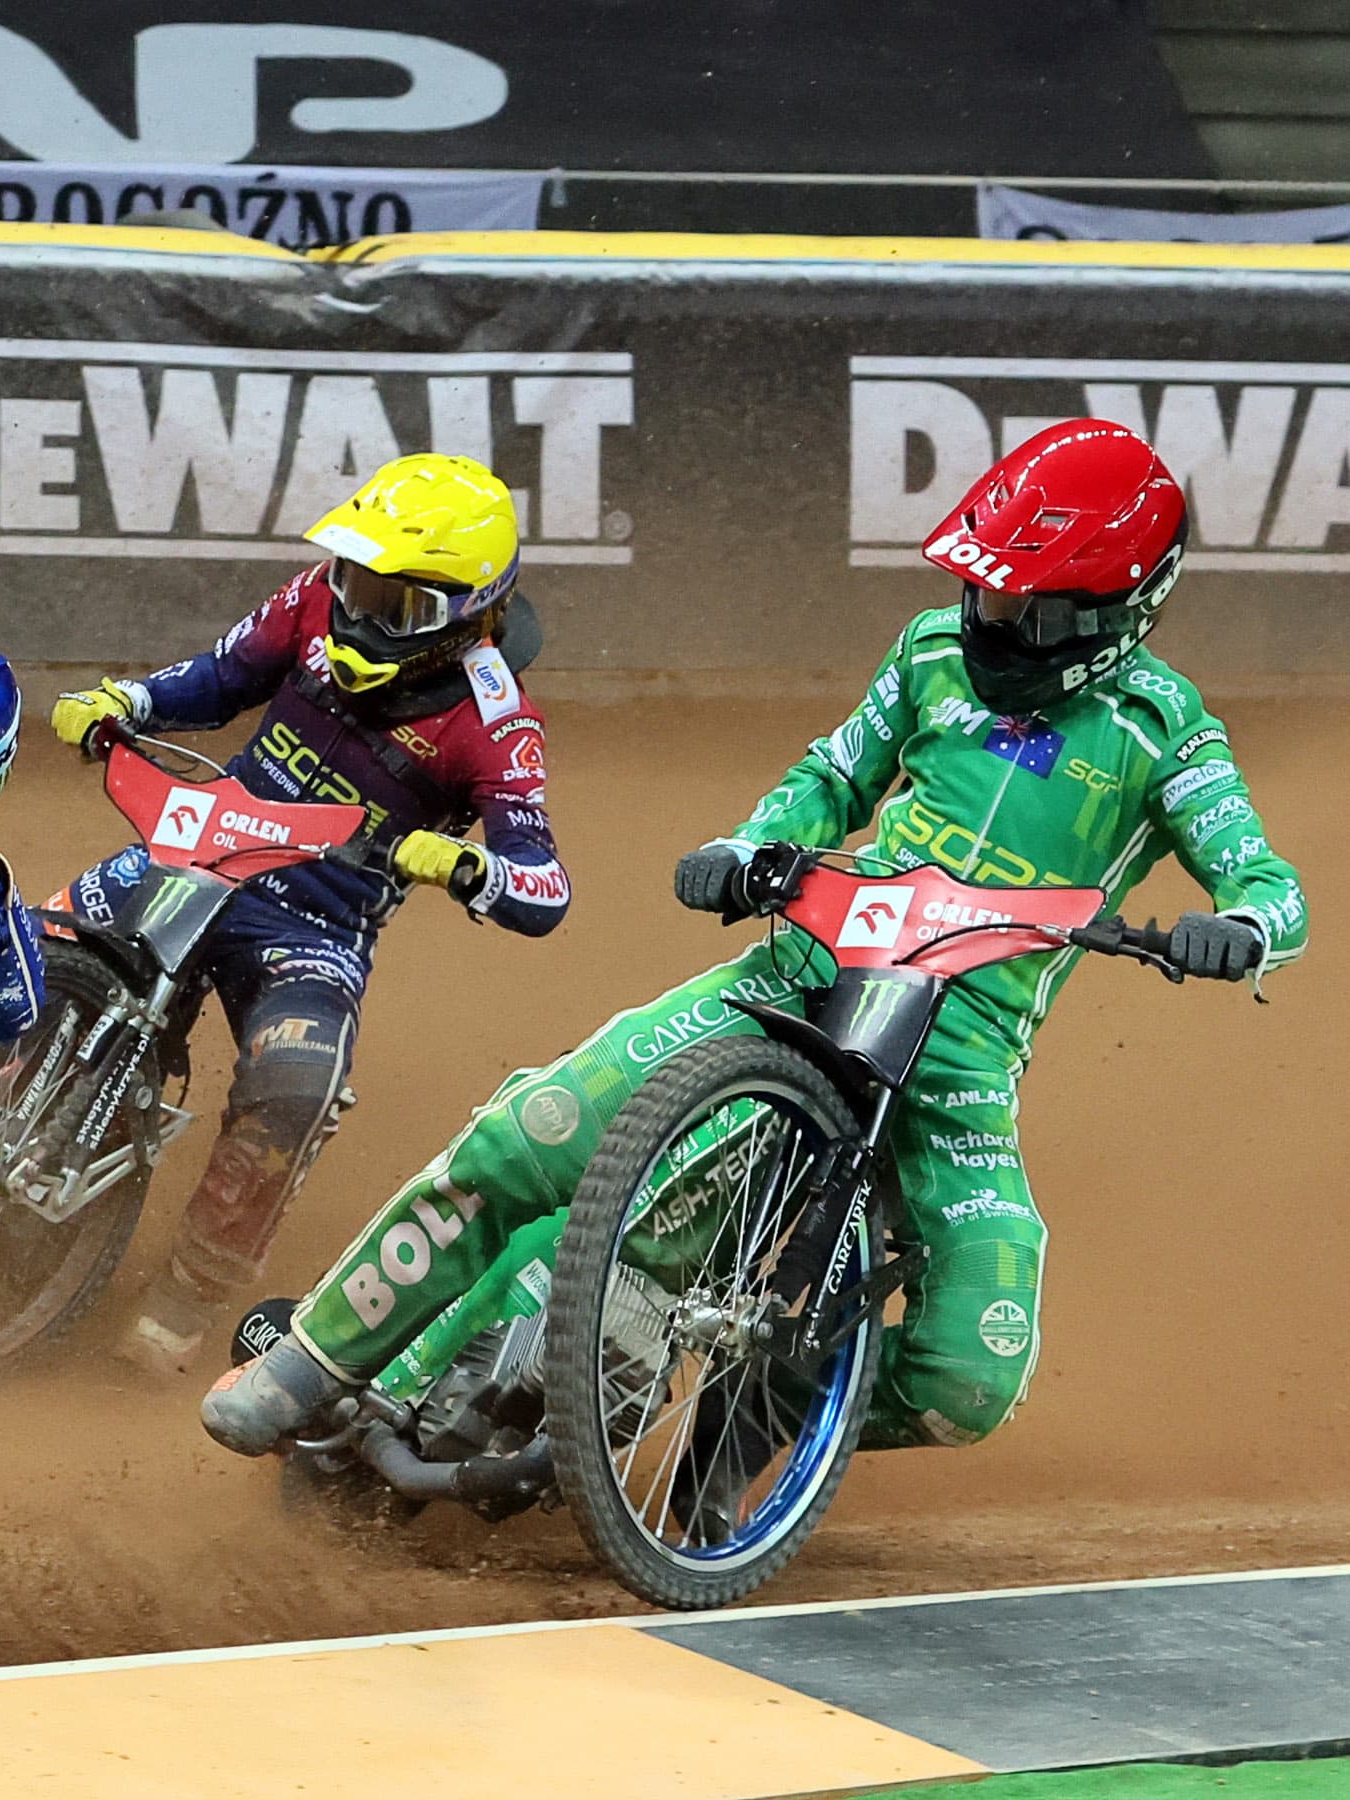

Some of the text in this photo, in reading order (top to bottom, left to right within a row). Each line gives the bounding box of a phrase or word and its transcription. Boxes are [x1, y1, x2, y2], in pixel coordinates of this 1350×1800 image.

[260, 758, 301, 798] SPEEDWA
[213, 832, 238, 850] OIL
[220, 810, 291, 844] ORLEN
[923, 902, 1013, 932] ORLEN
[946, 1090, 1010, 1108] ANLAS
[930, 1131, 1017, 1150] Richard
[951, 1151, 1020, 1170] Hayes
[341, 1174, 486, 1330] BOLL
[828, 1179, 872, 1295] GARCAREK
[243, 1313, 285, 1354] GARC
